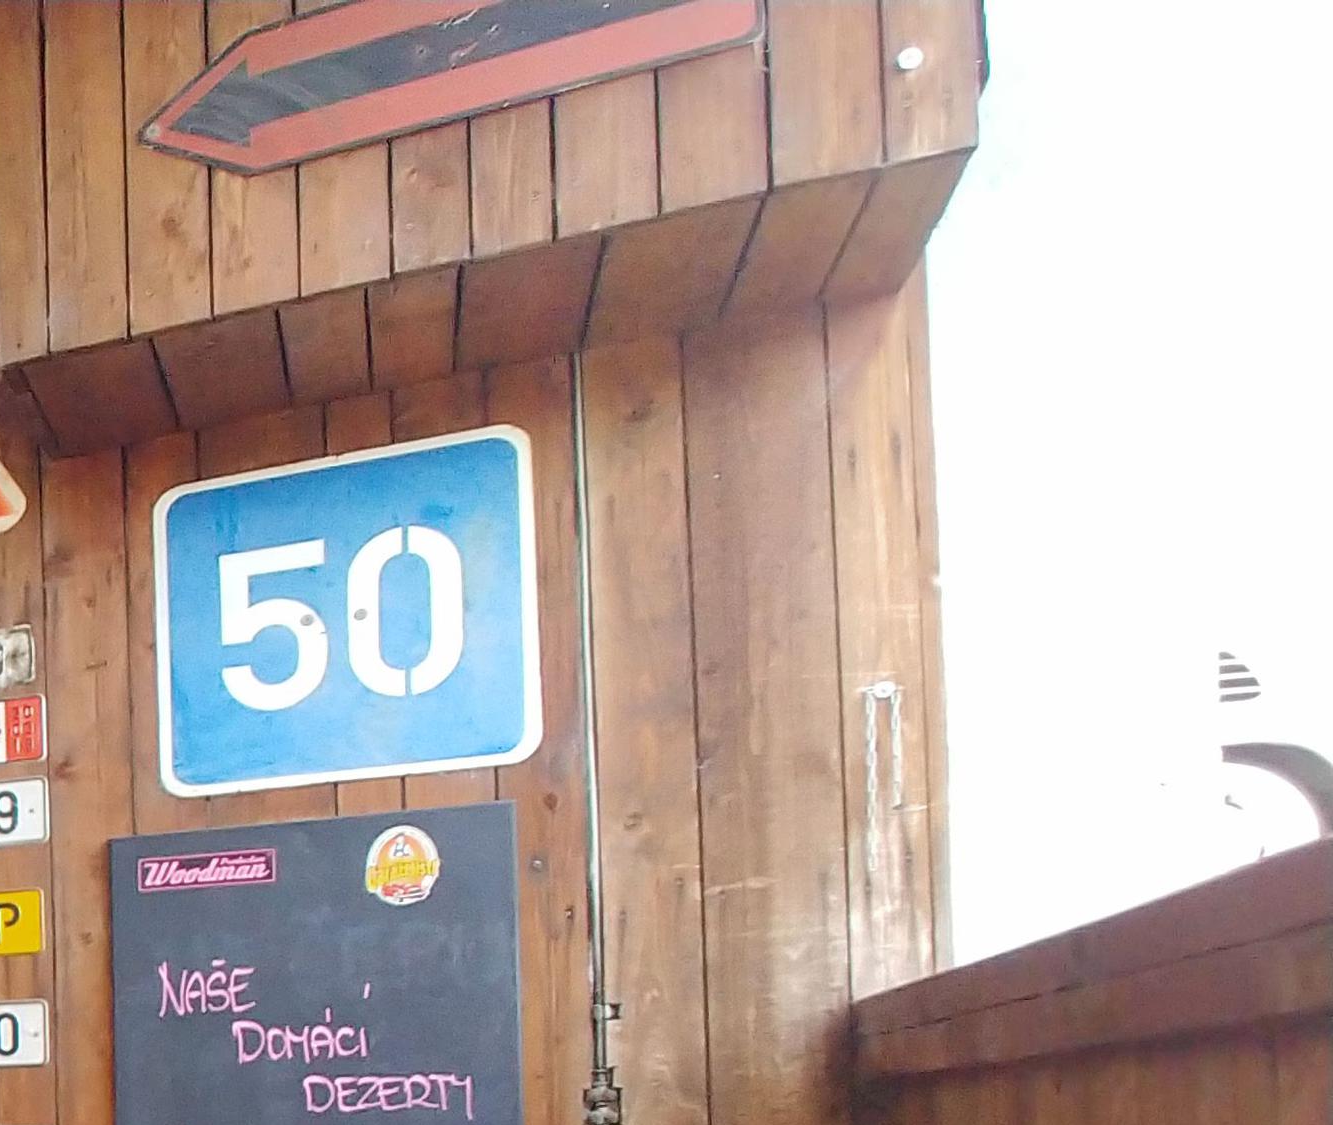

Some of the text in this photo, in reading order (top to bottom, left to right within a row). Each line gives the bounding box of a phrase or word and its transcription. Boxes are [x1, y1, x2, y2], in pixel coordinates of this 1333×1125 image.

[218, 524, 464, 711] 50
[144, 857, 270, 886] Woodman
[158, 960, 256, 1018] NAŠE
[303, 1074, 472, 1120] DEZERTY
